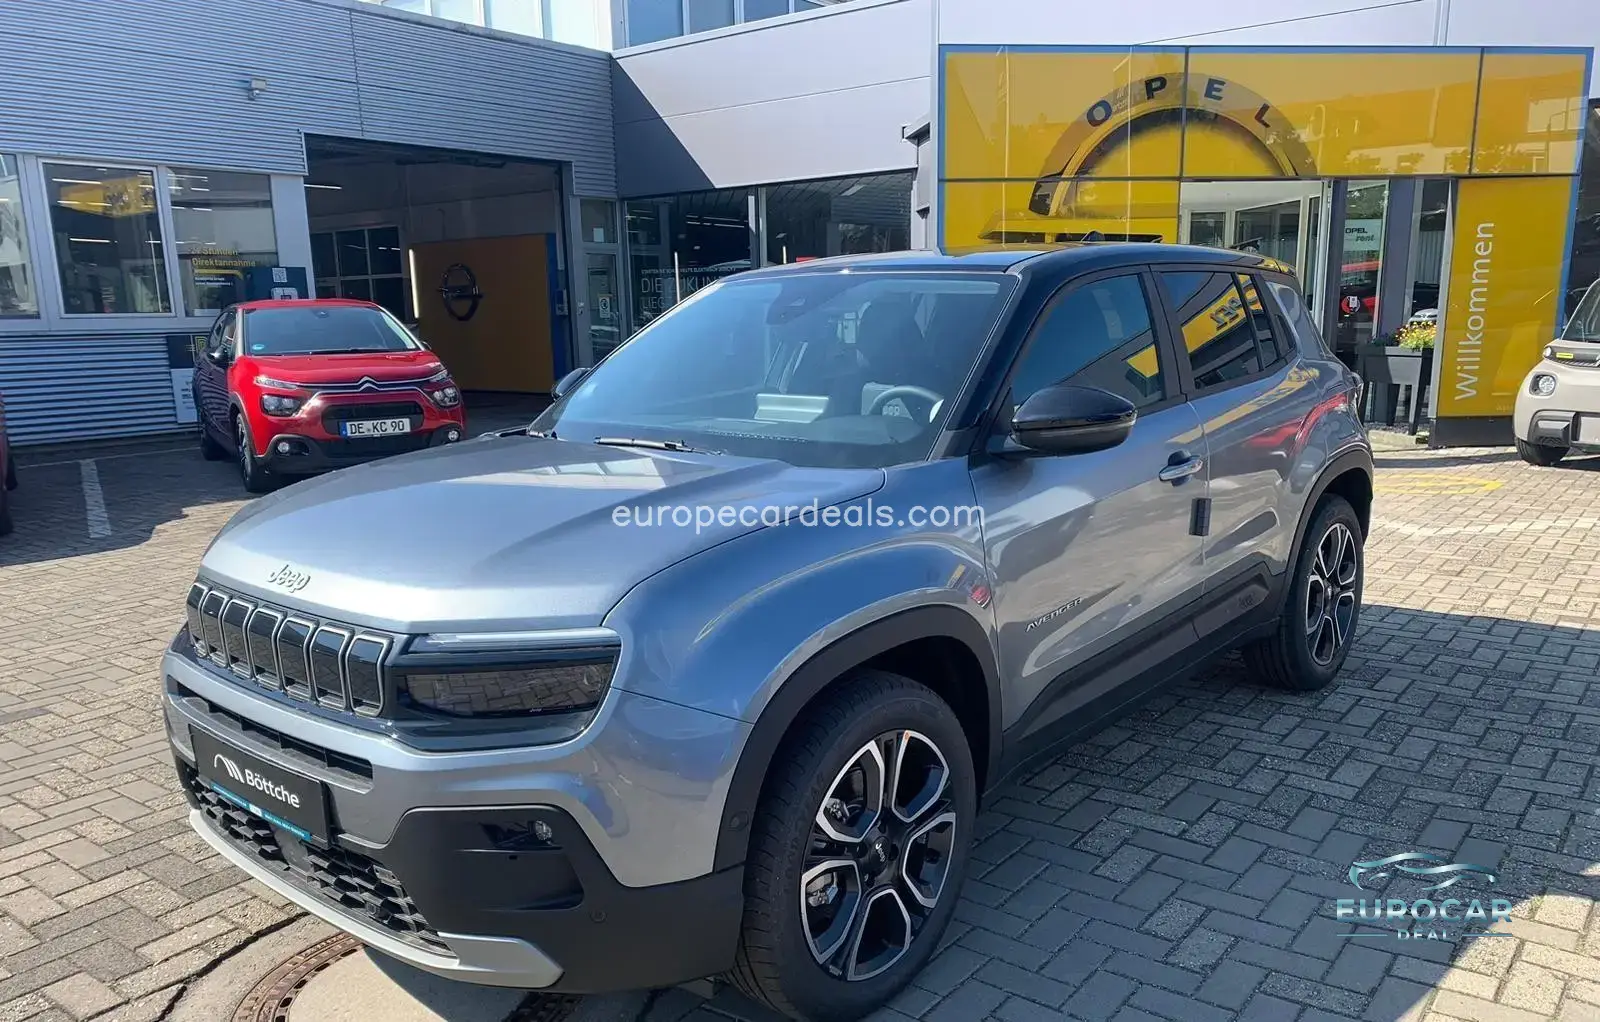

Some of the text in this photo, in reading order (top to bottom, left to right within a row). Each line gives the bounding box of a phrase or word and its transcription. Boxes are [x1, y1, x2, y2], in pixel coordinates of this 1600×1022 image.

[1086, 76, 1271, 128] OPEL
[192, 257, 256, 267] Direktannahme
[202, 247, 238, 256] Stunden
[641, 277, 663, 293] DIE
[1454, 222, 1495, 400] Willkommen
[350, 420, 405, 434] DE KC 90
[267, 564, 311, 594] Jeep
[1025, 596, 1081, 633] AVENGER
[244, 768, 300, 808] Böttche
